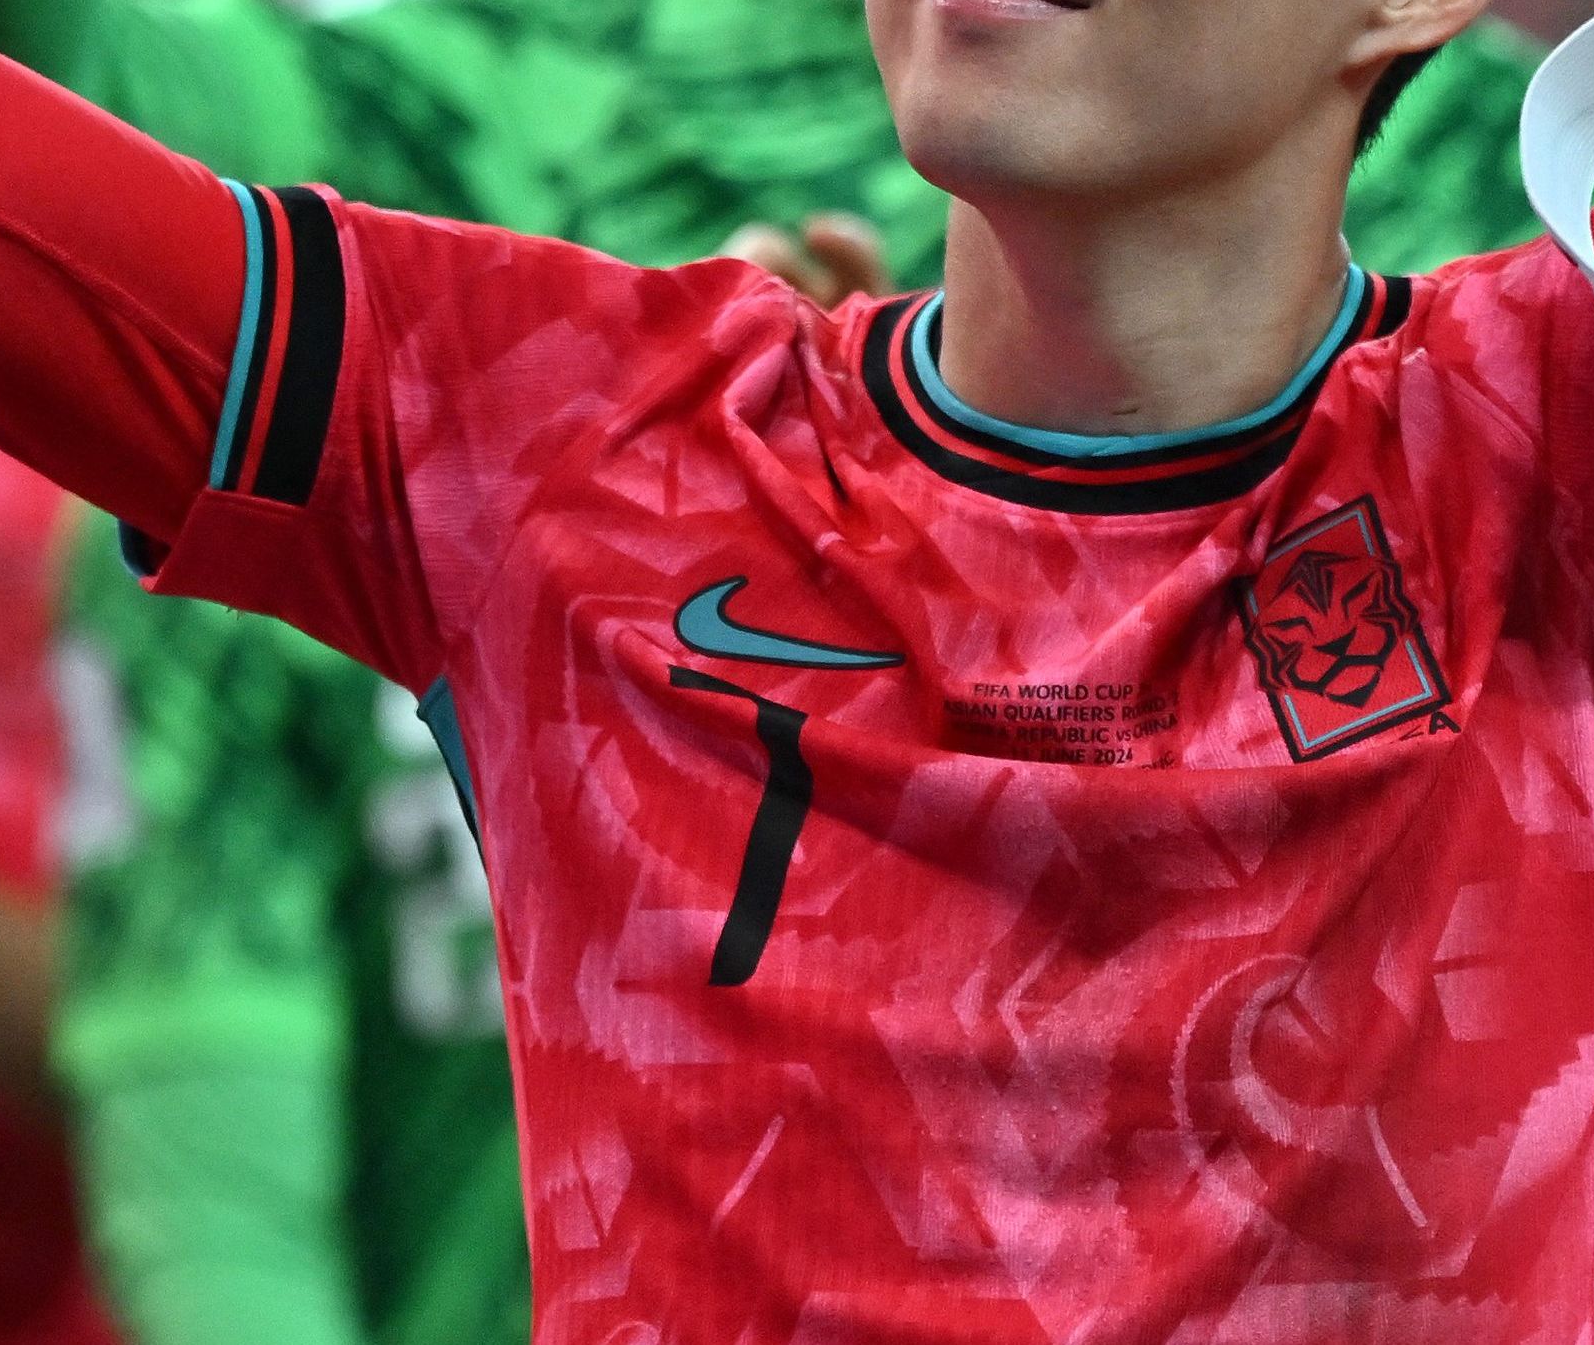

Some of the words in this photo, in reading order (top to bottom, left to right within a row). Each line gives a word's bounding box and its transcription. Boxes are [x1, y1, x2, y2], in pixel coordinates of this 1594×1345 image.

[972, 682, 1010, 698] FIFA
[1018, 684, 1089, 701] WORLD
[1095, 684, 1134, 701] CUP
[1005, 704, 1115, 722] QUALIFIERS
[1016, 726, 1110, 744] REPUBLIC
[1133, 712, 1179, 739] CHINA
[1093, 747, 1134, 766] 2024
[668, 664, 814, 987] 7
